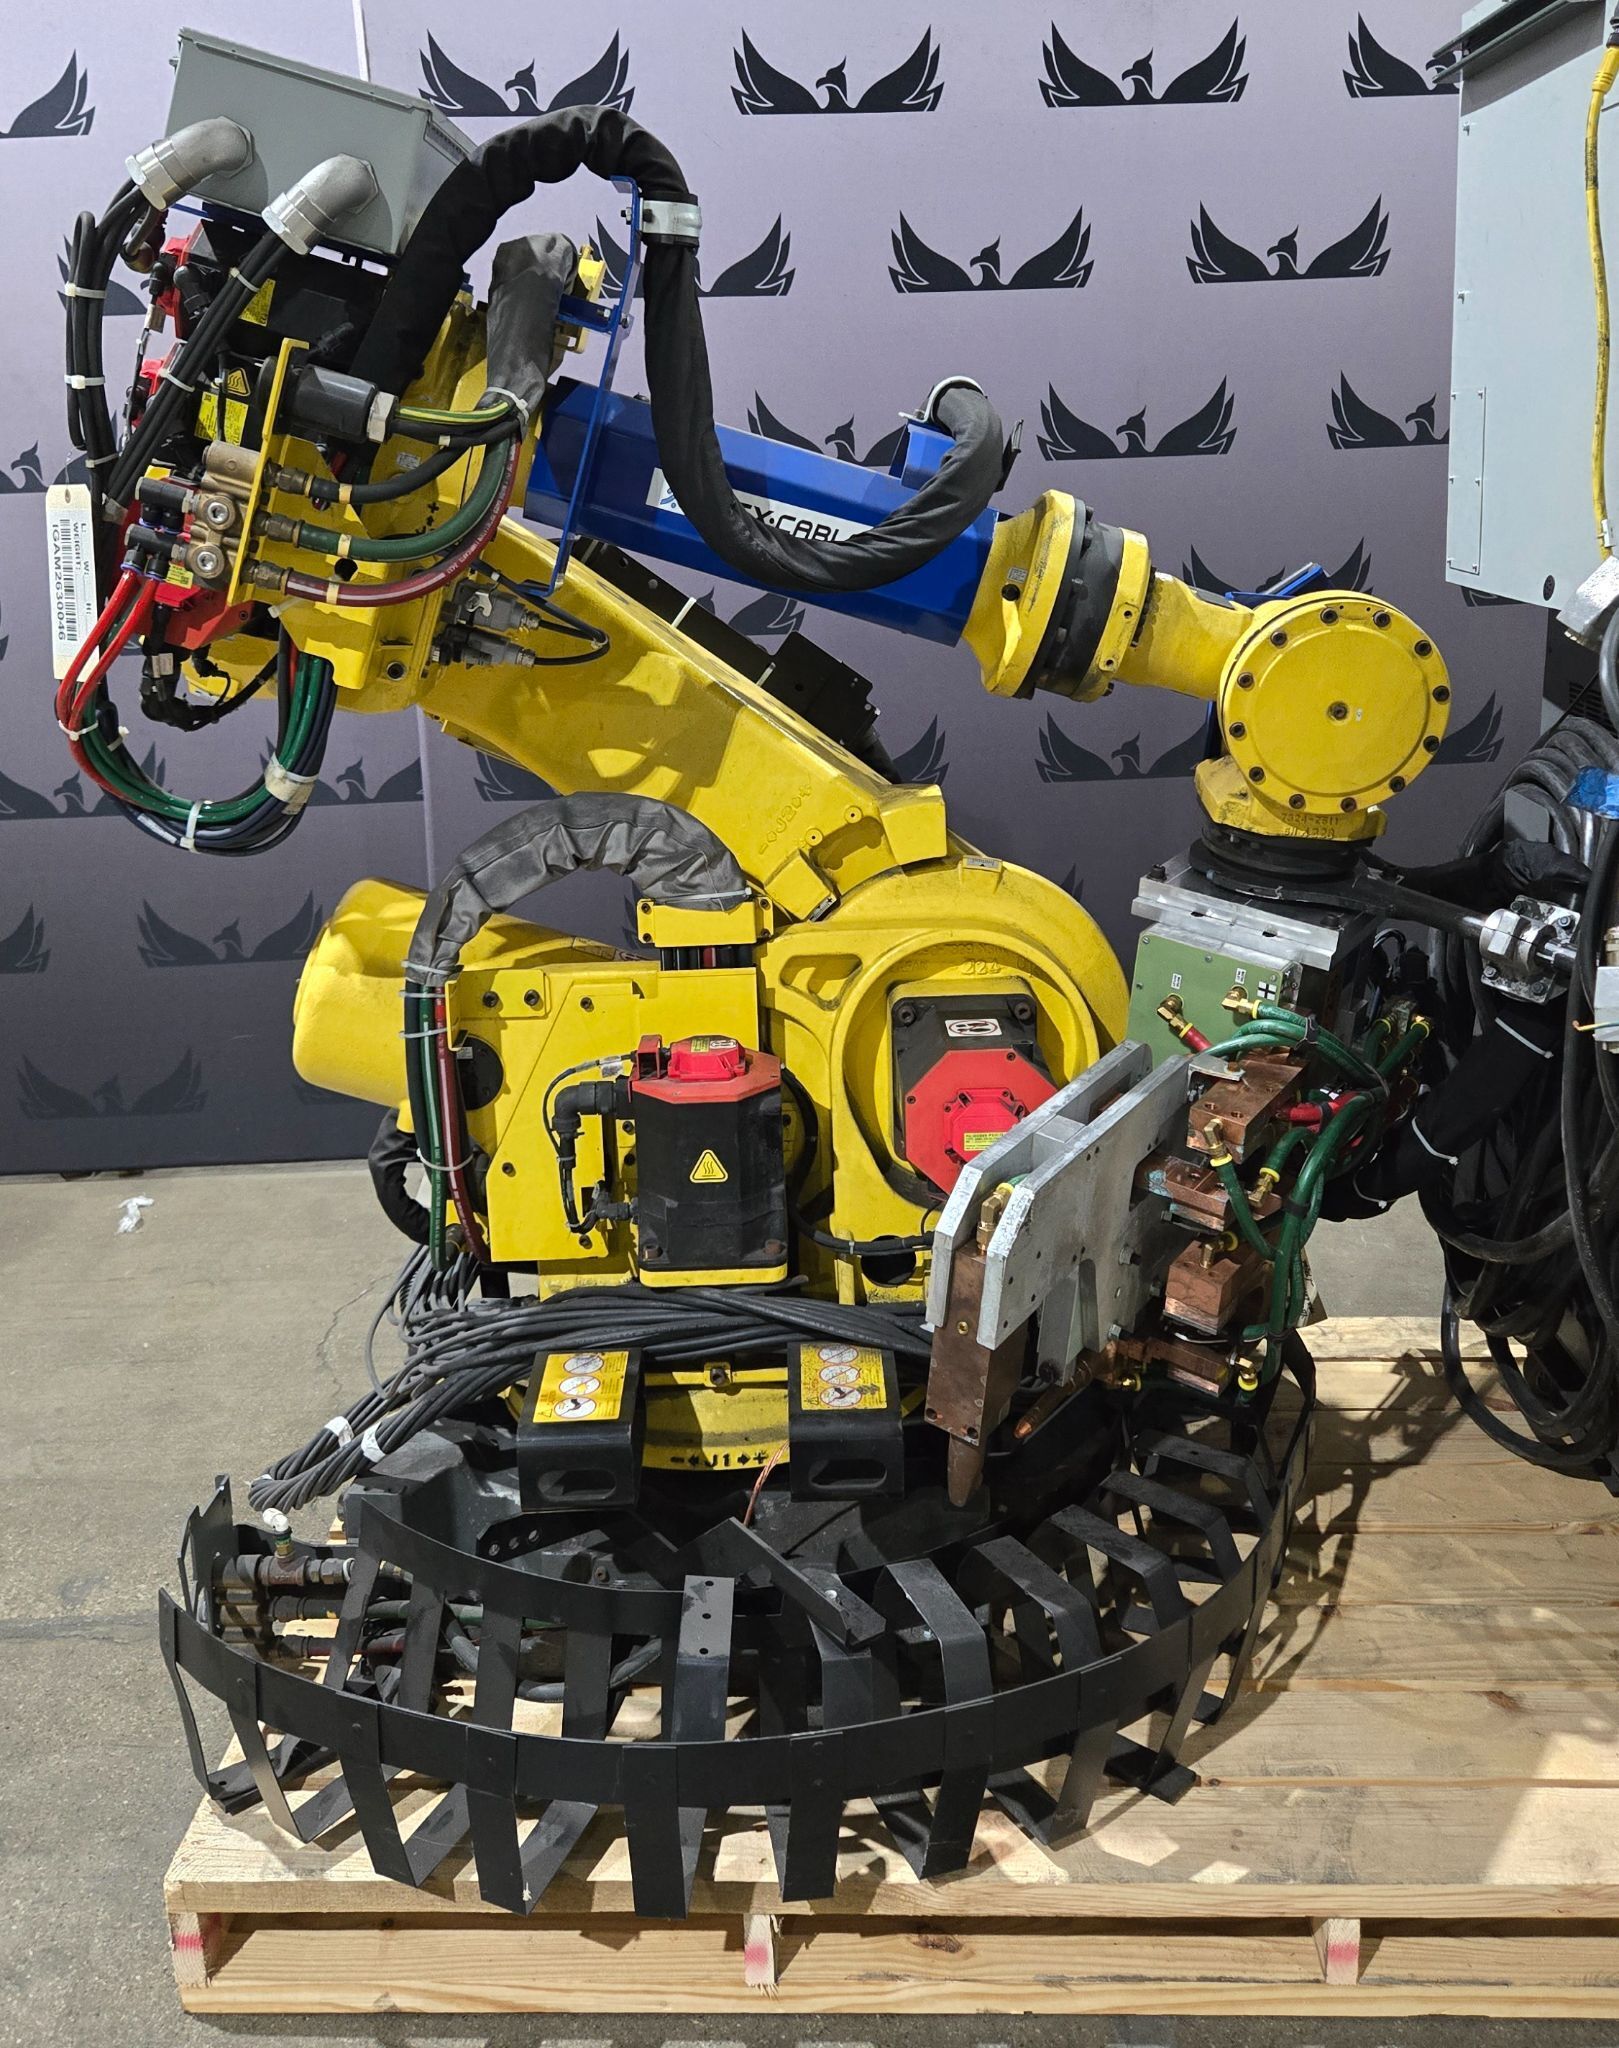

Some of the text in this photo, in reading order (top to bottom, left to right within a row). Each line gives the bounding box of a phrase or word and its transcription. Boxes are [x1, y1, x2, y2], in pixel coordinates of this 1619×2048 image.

[73, 521, 81, 571] WEIGHT:
[52, 524, 66, 641] IGAM2630046
[703, 1452, 731, 1468] J1
